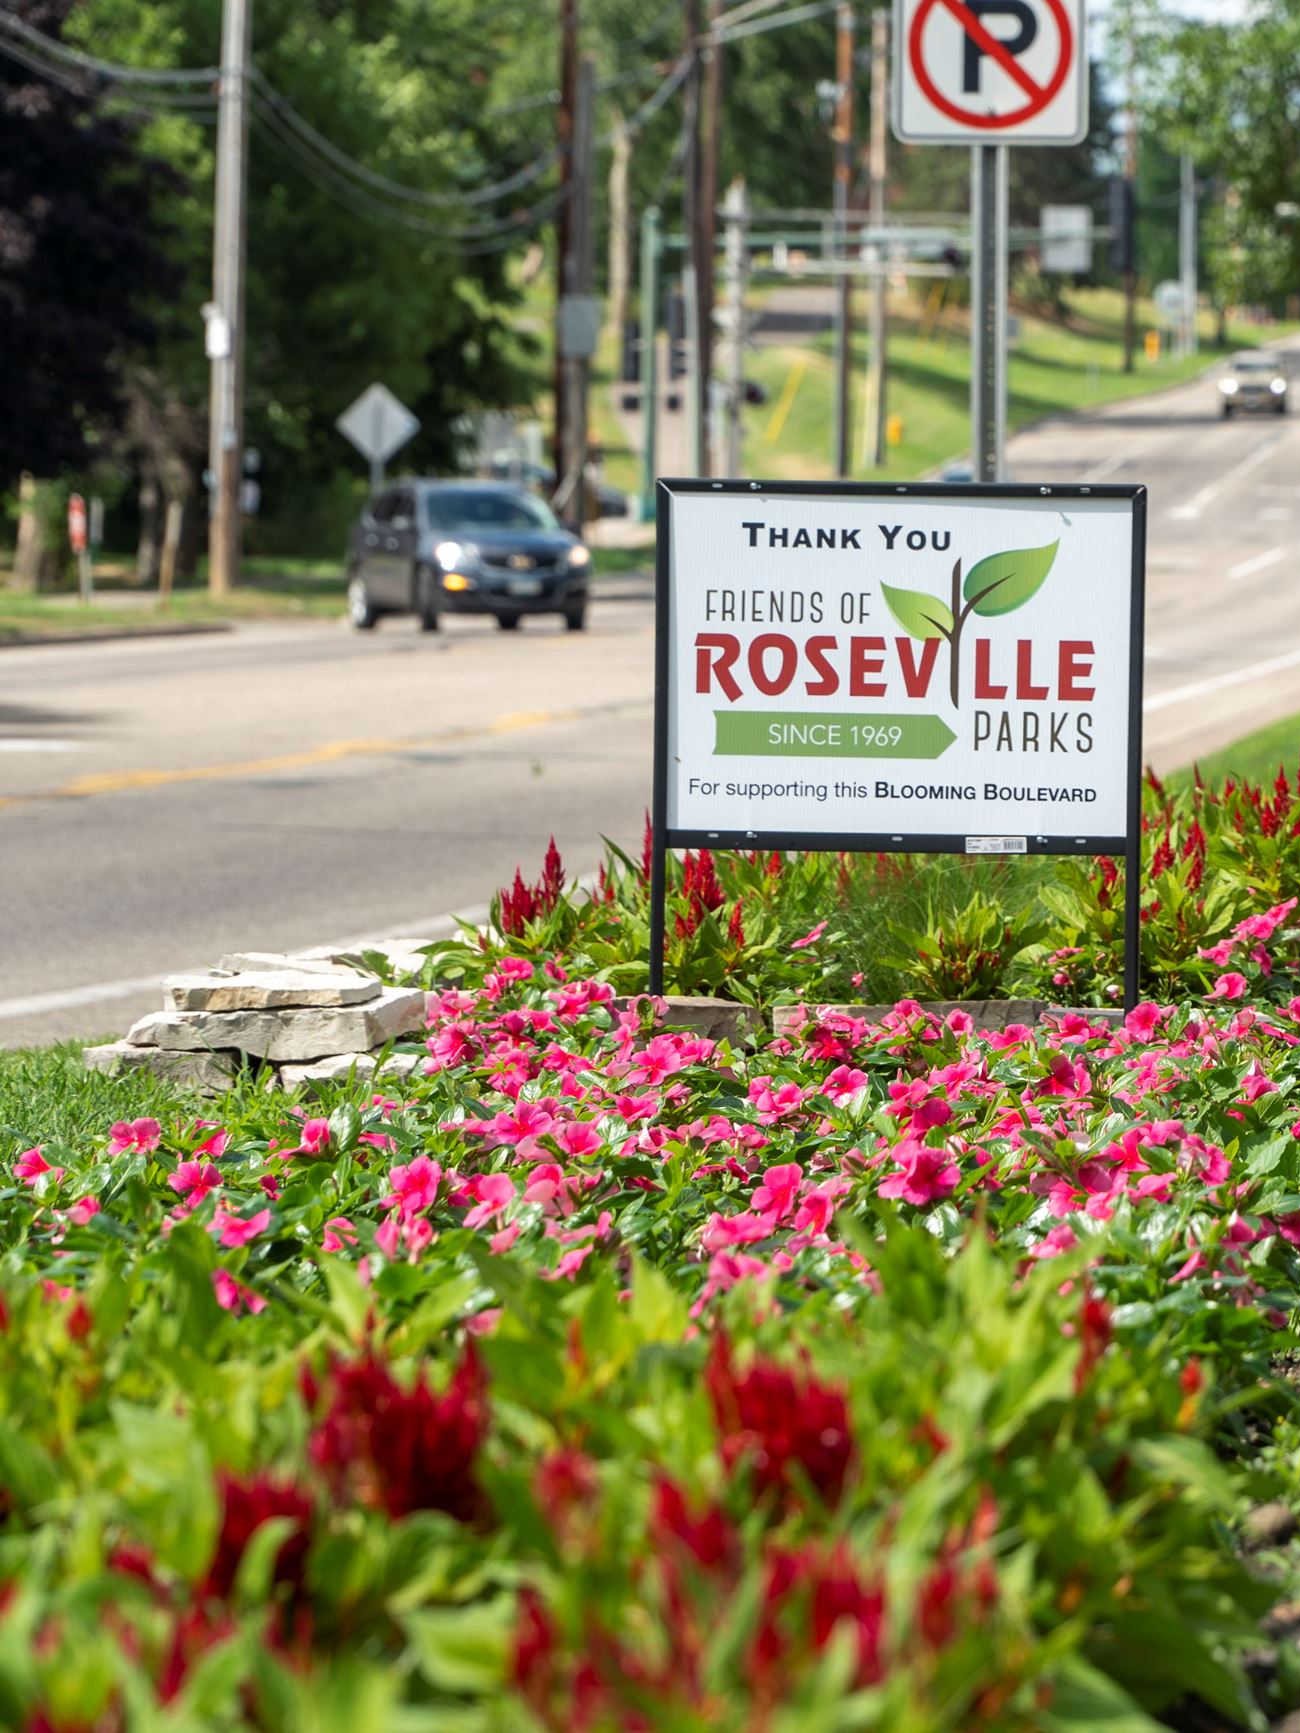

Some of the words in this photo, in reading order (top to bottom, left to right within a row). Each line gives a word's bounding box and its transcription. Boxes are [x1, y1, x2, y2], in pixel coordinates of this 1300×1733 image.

[742, 522, 861, 549] THANK
[878, 525, 951, 551] YOU
[706, 589, 823, 624] FRIENDS
[841, 592, 871, 624] OF
[768, 724, 841, 746] SINCE
[850, 725, 902, 748] 1969
[974, 711, 1093, 753] PARKS
[689, 778, 720, 795] For
[726, 780, 828, 801] supporting
[834, 781, 868, 798] this
[875, 781, 976, 800] BLOOMING
[984, 784, 1097, 802] BOULEVARD
